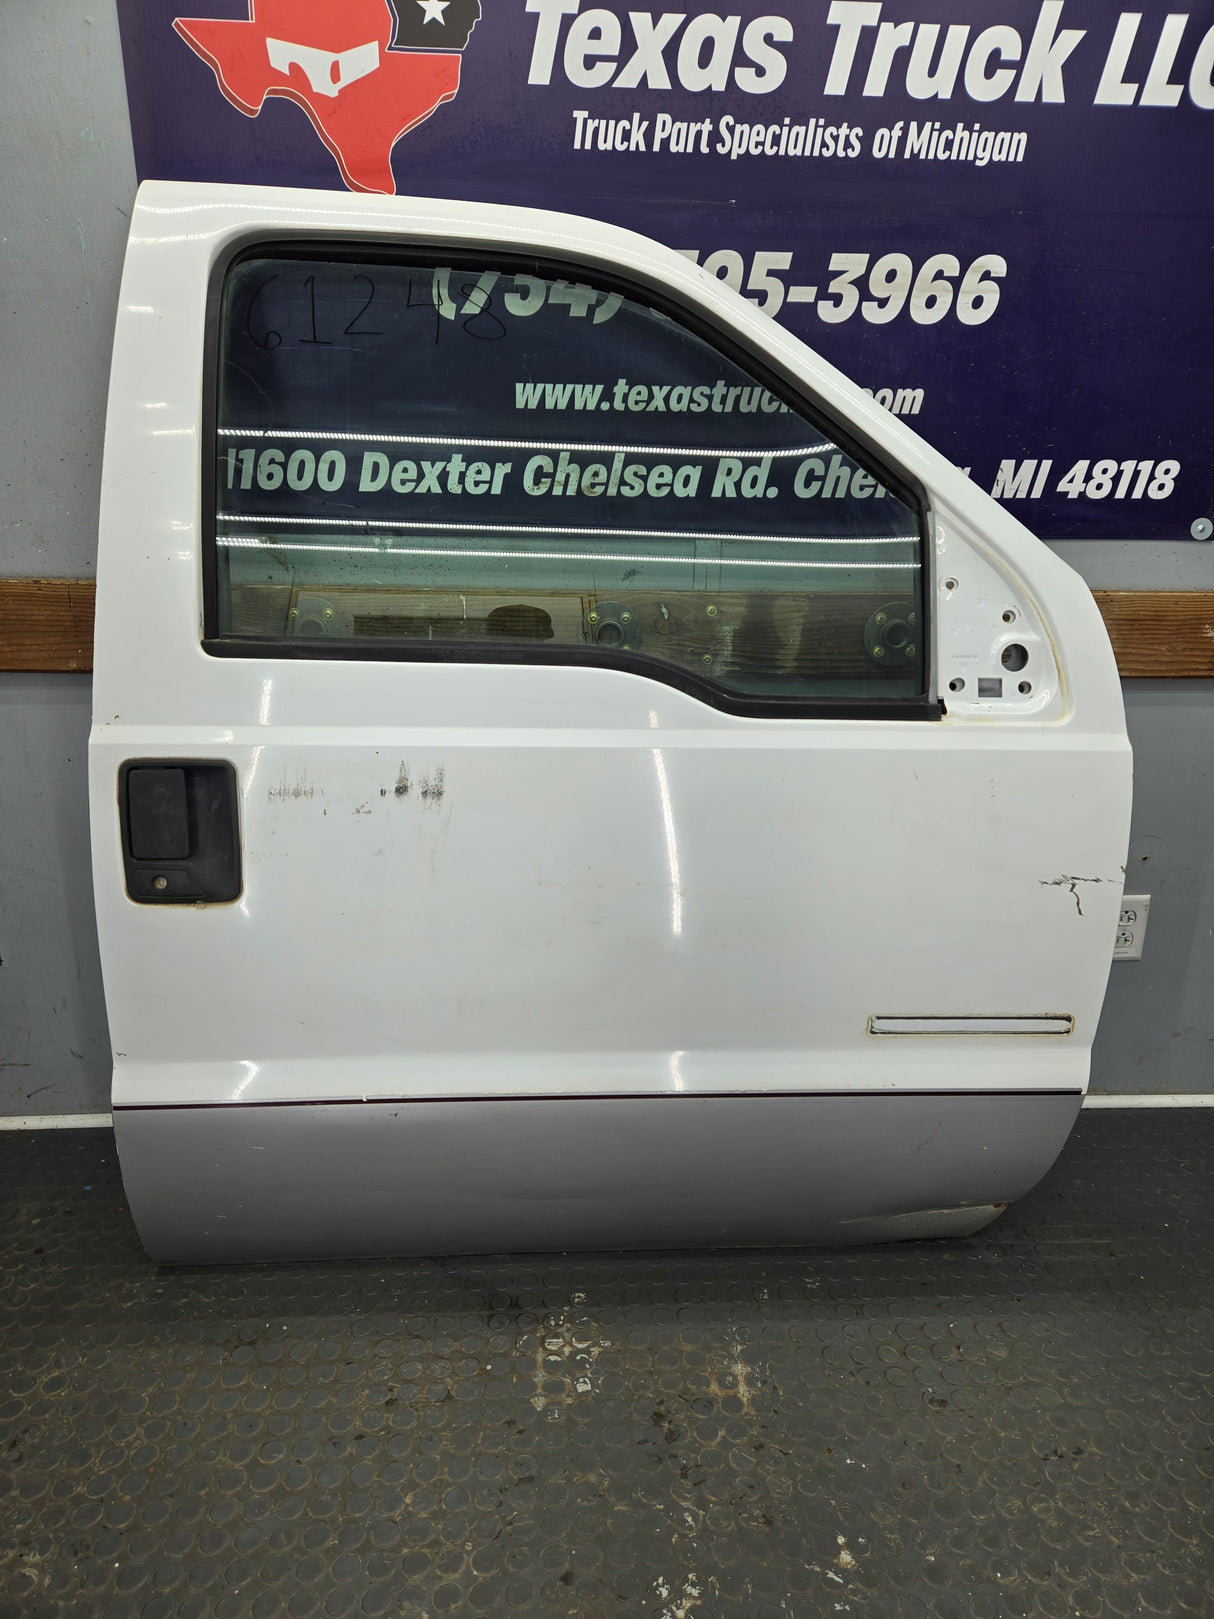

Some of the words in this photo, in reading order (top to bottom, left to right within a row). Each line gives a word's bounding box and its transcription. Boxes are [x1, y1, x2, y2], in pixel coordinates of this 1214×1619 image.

[525, 0, 794, 93] Texas
[823, 0, 1087, 104] Truck
[572, 110, 648, 152] Truck
[653, 112, 712, 154] Part
[716, 115, 862, 160] Specialists
[872, 121, 902, 157] of
[903, 121, 1028, 166] Michigan
[674, 248, 1007, 326] 95-3966
[227, 448, 346, 492] 11600
[358, 451, 512, 495] Dexter
[523, 452, 701, 499] Chelsea
[710, 456, 779, 499] Rd.
[990, 458, 1052, 500] MI
[1056, 459, 1181, 501] 48118
